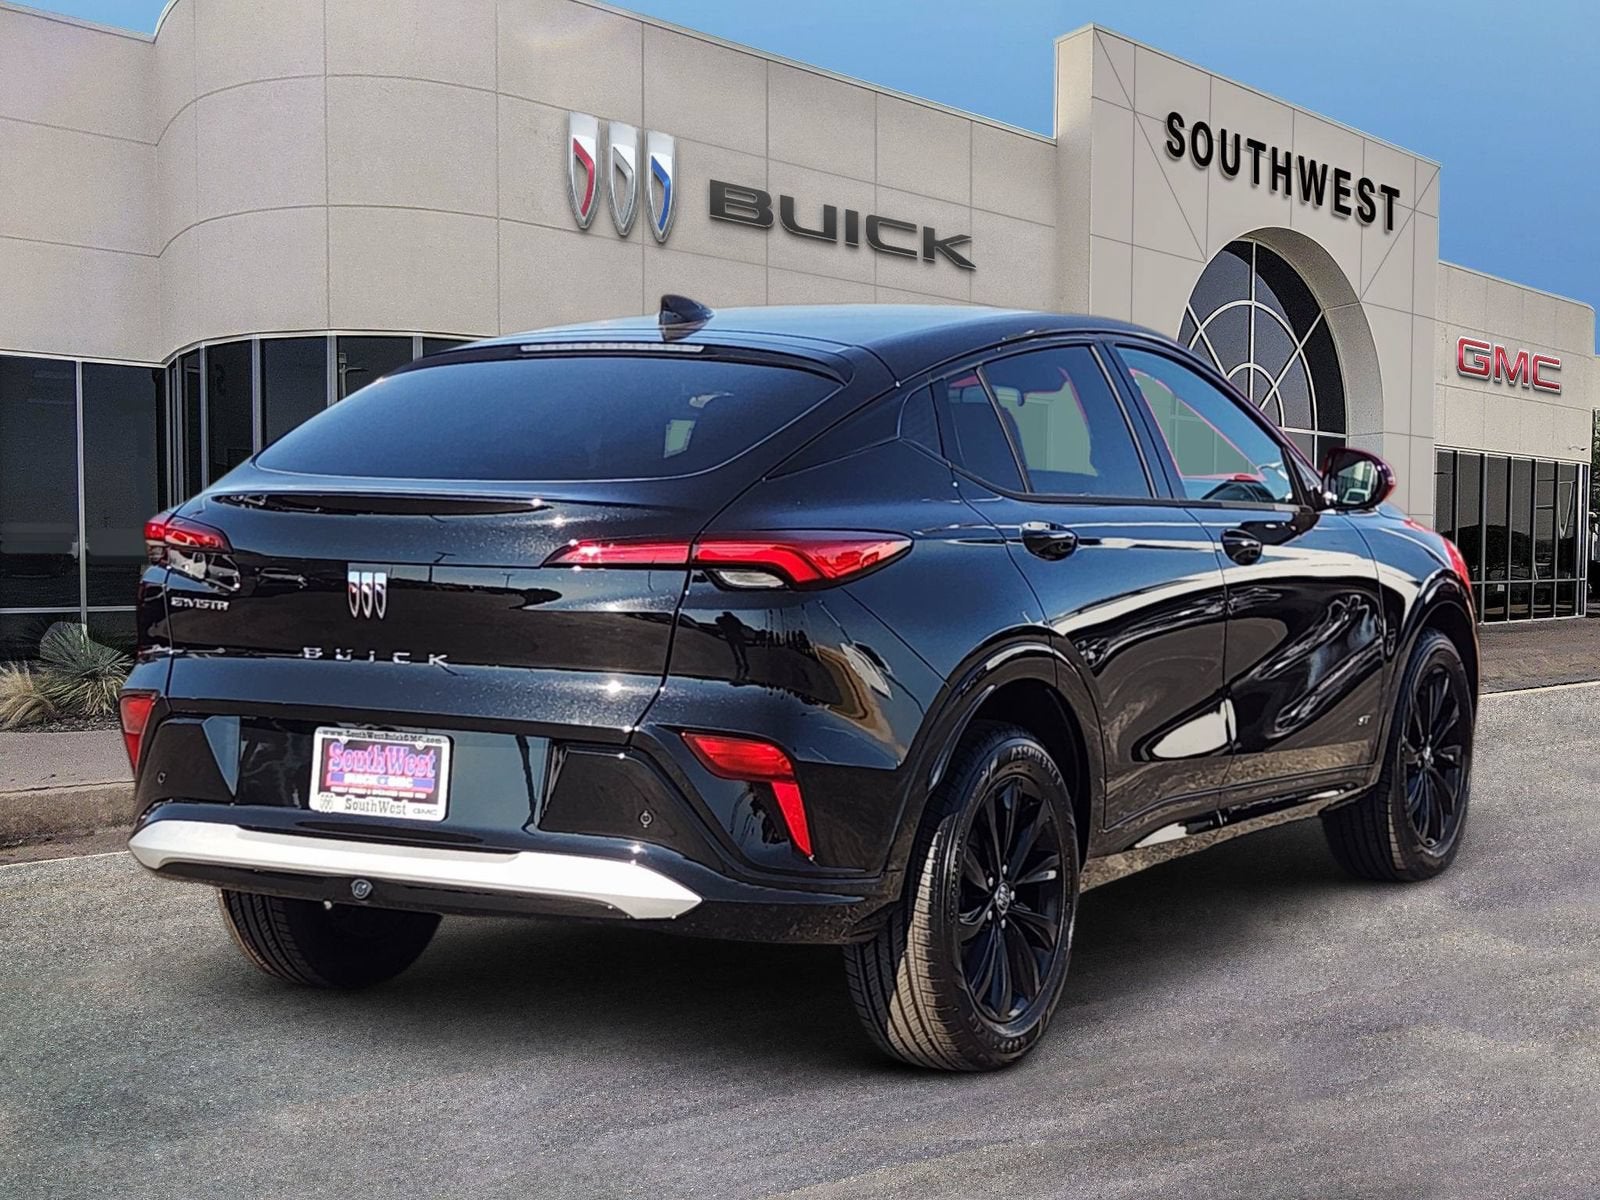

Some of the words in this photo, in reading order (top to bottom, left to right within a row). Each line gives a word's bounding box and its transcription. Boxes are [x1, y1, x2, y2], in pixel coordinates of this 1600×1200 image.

[1165, 111, 1400, 232] SOUTHWEST
[709, 179, 976, 270] BUICK
[1457, 336, 1561, 394] GMC
[303, 647, 450, 667] BUICK
[328, 742, 436, 777] SouthWest
[344, 798, 407, 815] SouthWest
